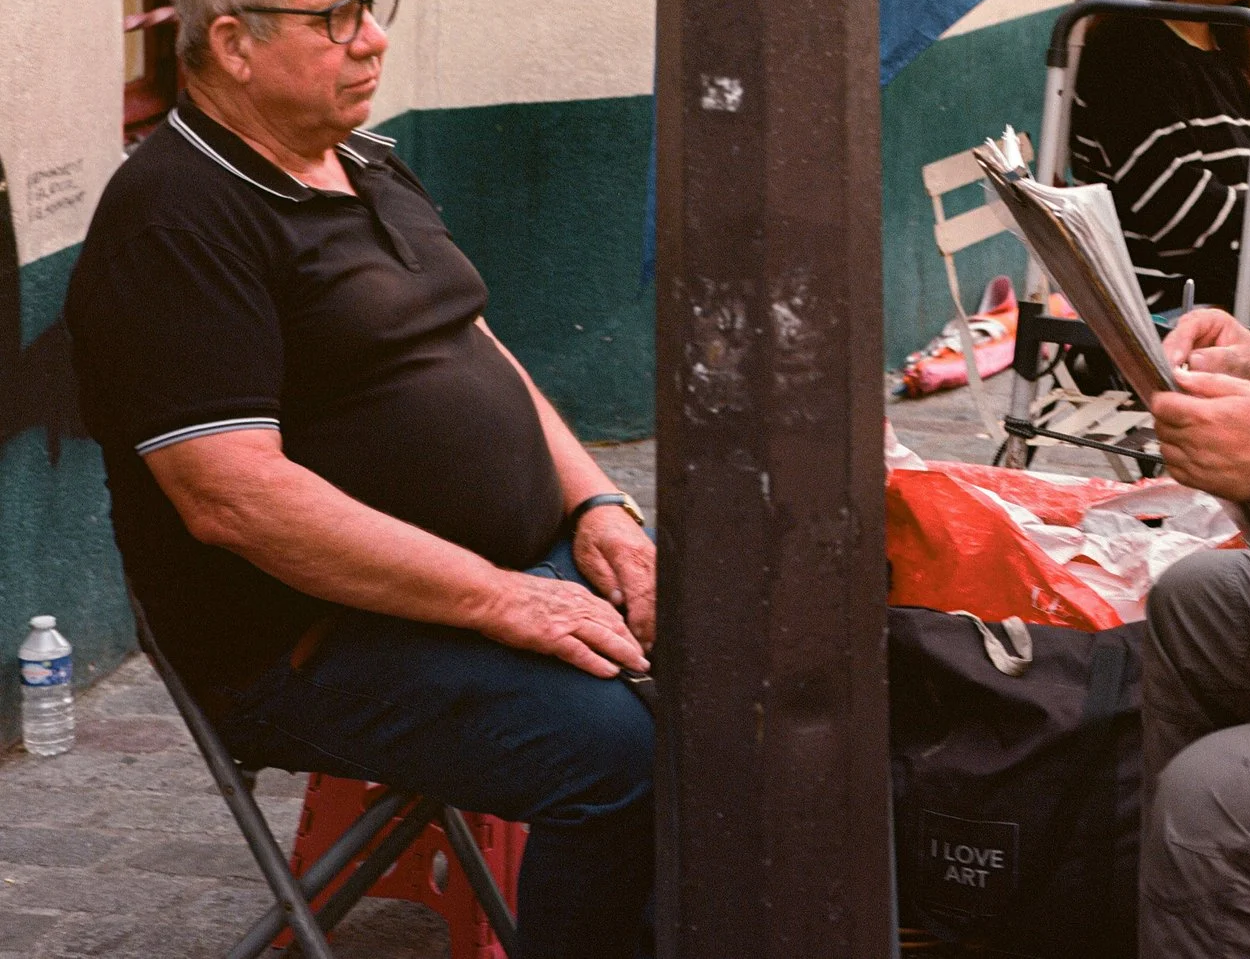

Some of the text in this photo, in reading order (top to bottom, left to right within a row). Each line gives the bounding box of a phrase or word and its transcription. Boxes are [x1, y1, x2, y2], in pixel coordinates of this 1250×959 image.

[931, 839, 1005, 869] I LOVE
[944, 865, 990, 888] ART
